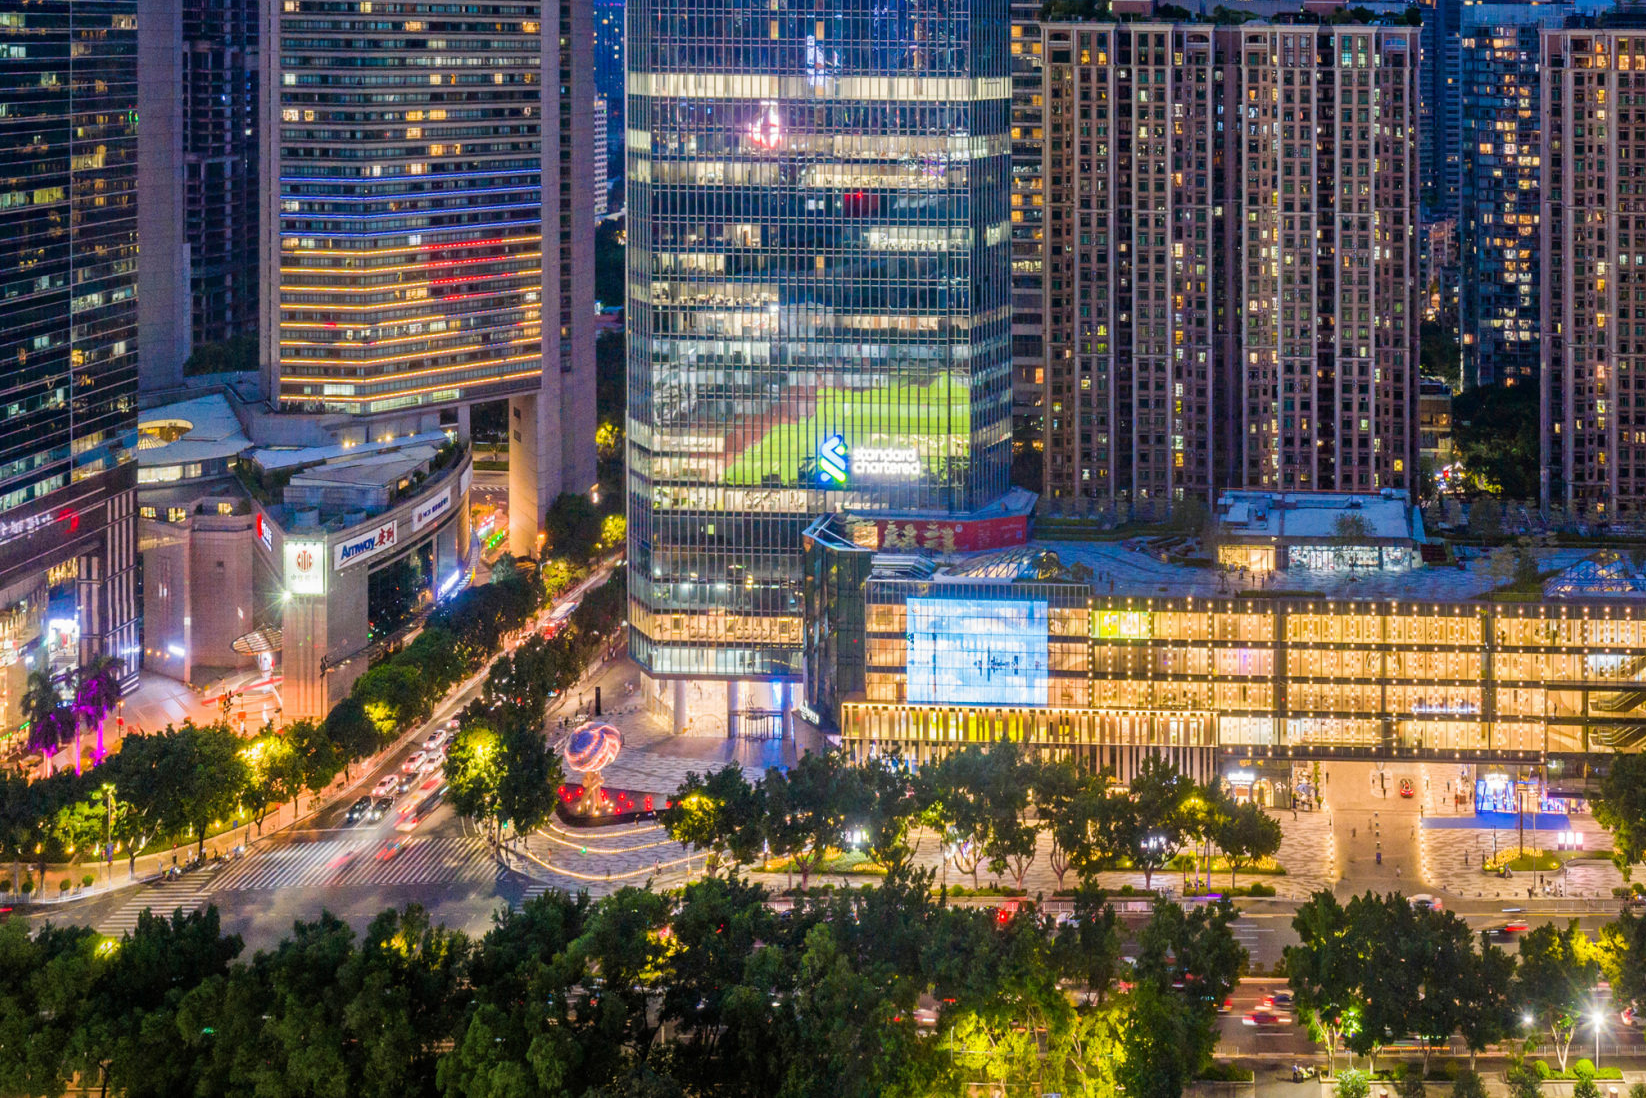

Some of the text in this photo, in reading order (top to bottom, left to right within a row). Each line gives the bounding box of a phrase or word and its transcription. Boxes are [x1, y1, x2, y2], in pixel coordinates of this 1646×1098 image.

[853, 447, 916, 461] standard
[853, 459, 920, 474] chartered
[340, 521, 395, 561] Amway 安利
